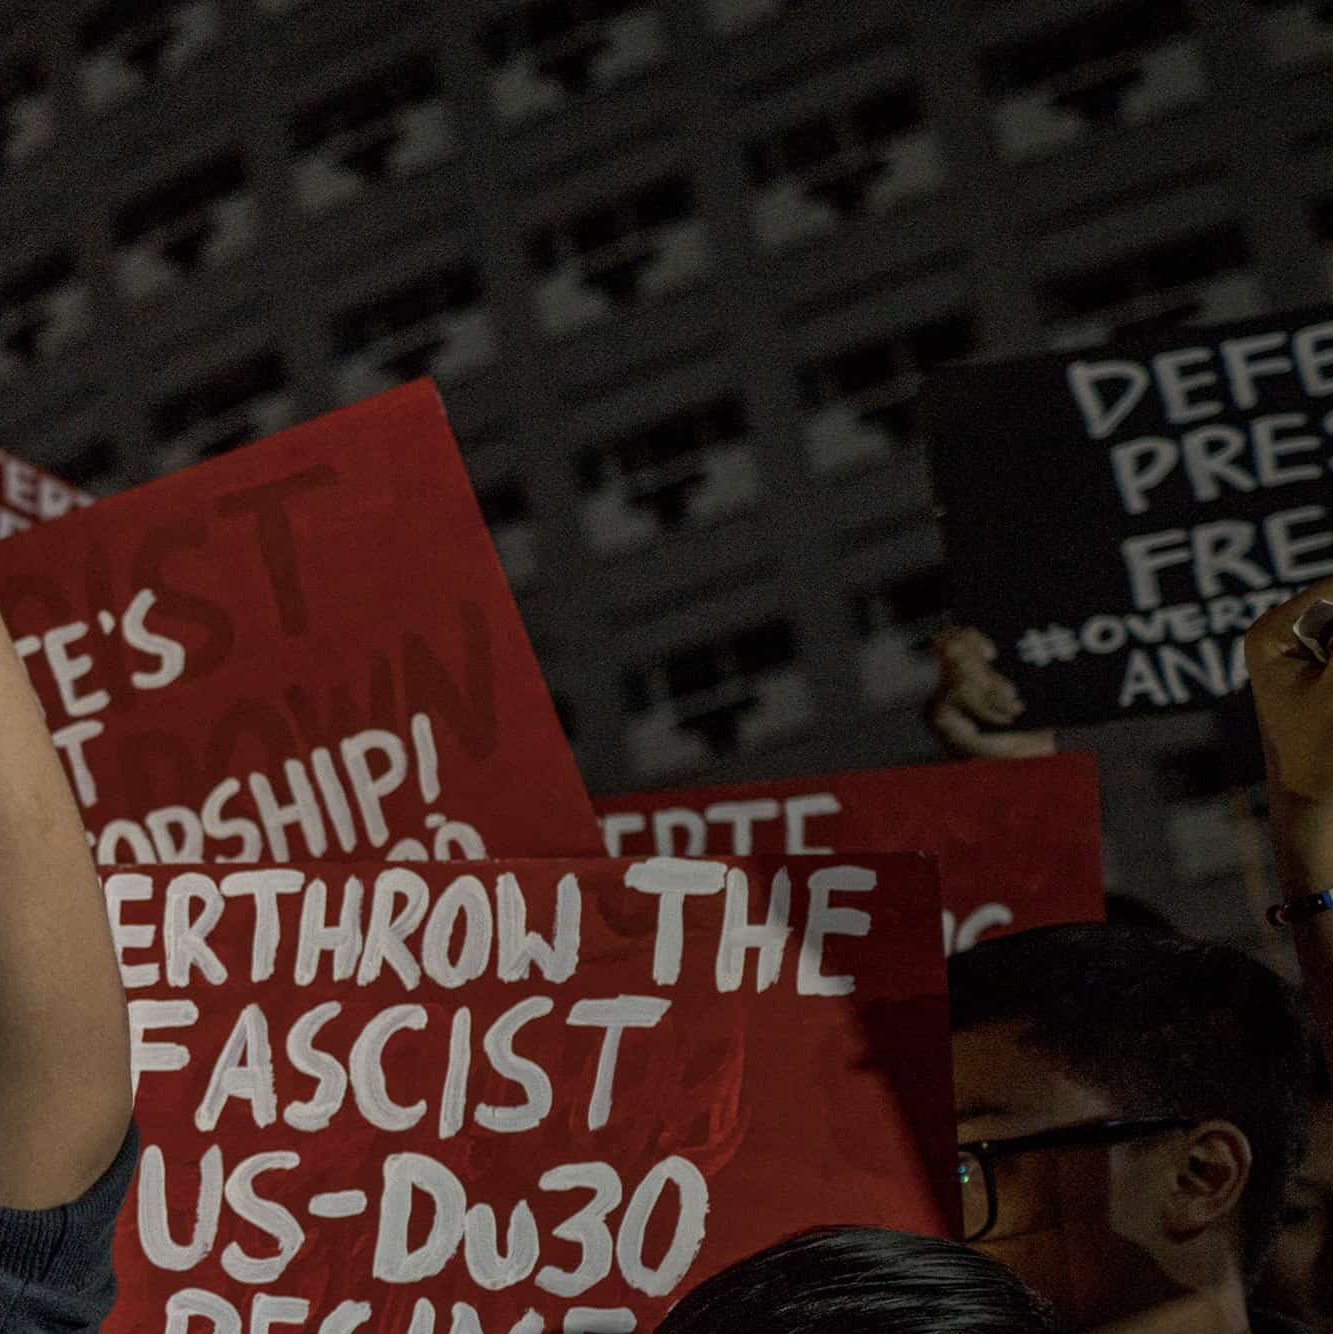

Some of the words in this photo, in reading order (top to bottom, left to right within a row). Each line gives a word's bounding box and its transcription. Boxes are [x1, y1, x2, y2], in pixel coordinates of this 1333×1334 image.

[1111, 412, 1333, 516] PRE
[96, 868, 580, 990] ERTHROW
[623, 856, 879, 996] THE
[128, 995, 673, 1138] FASCIST
[136, 1143, 711, 1298] US-Du30
